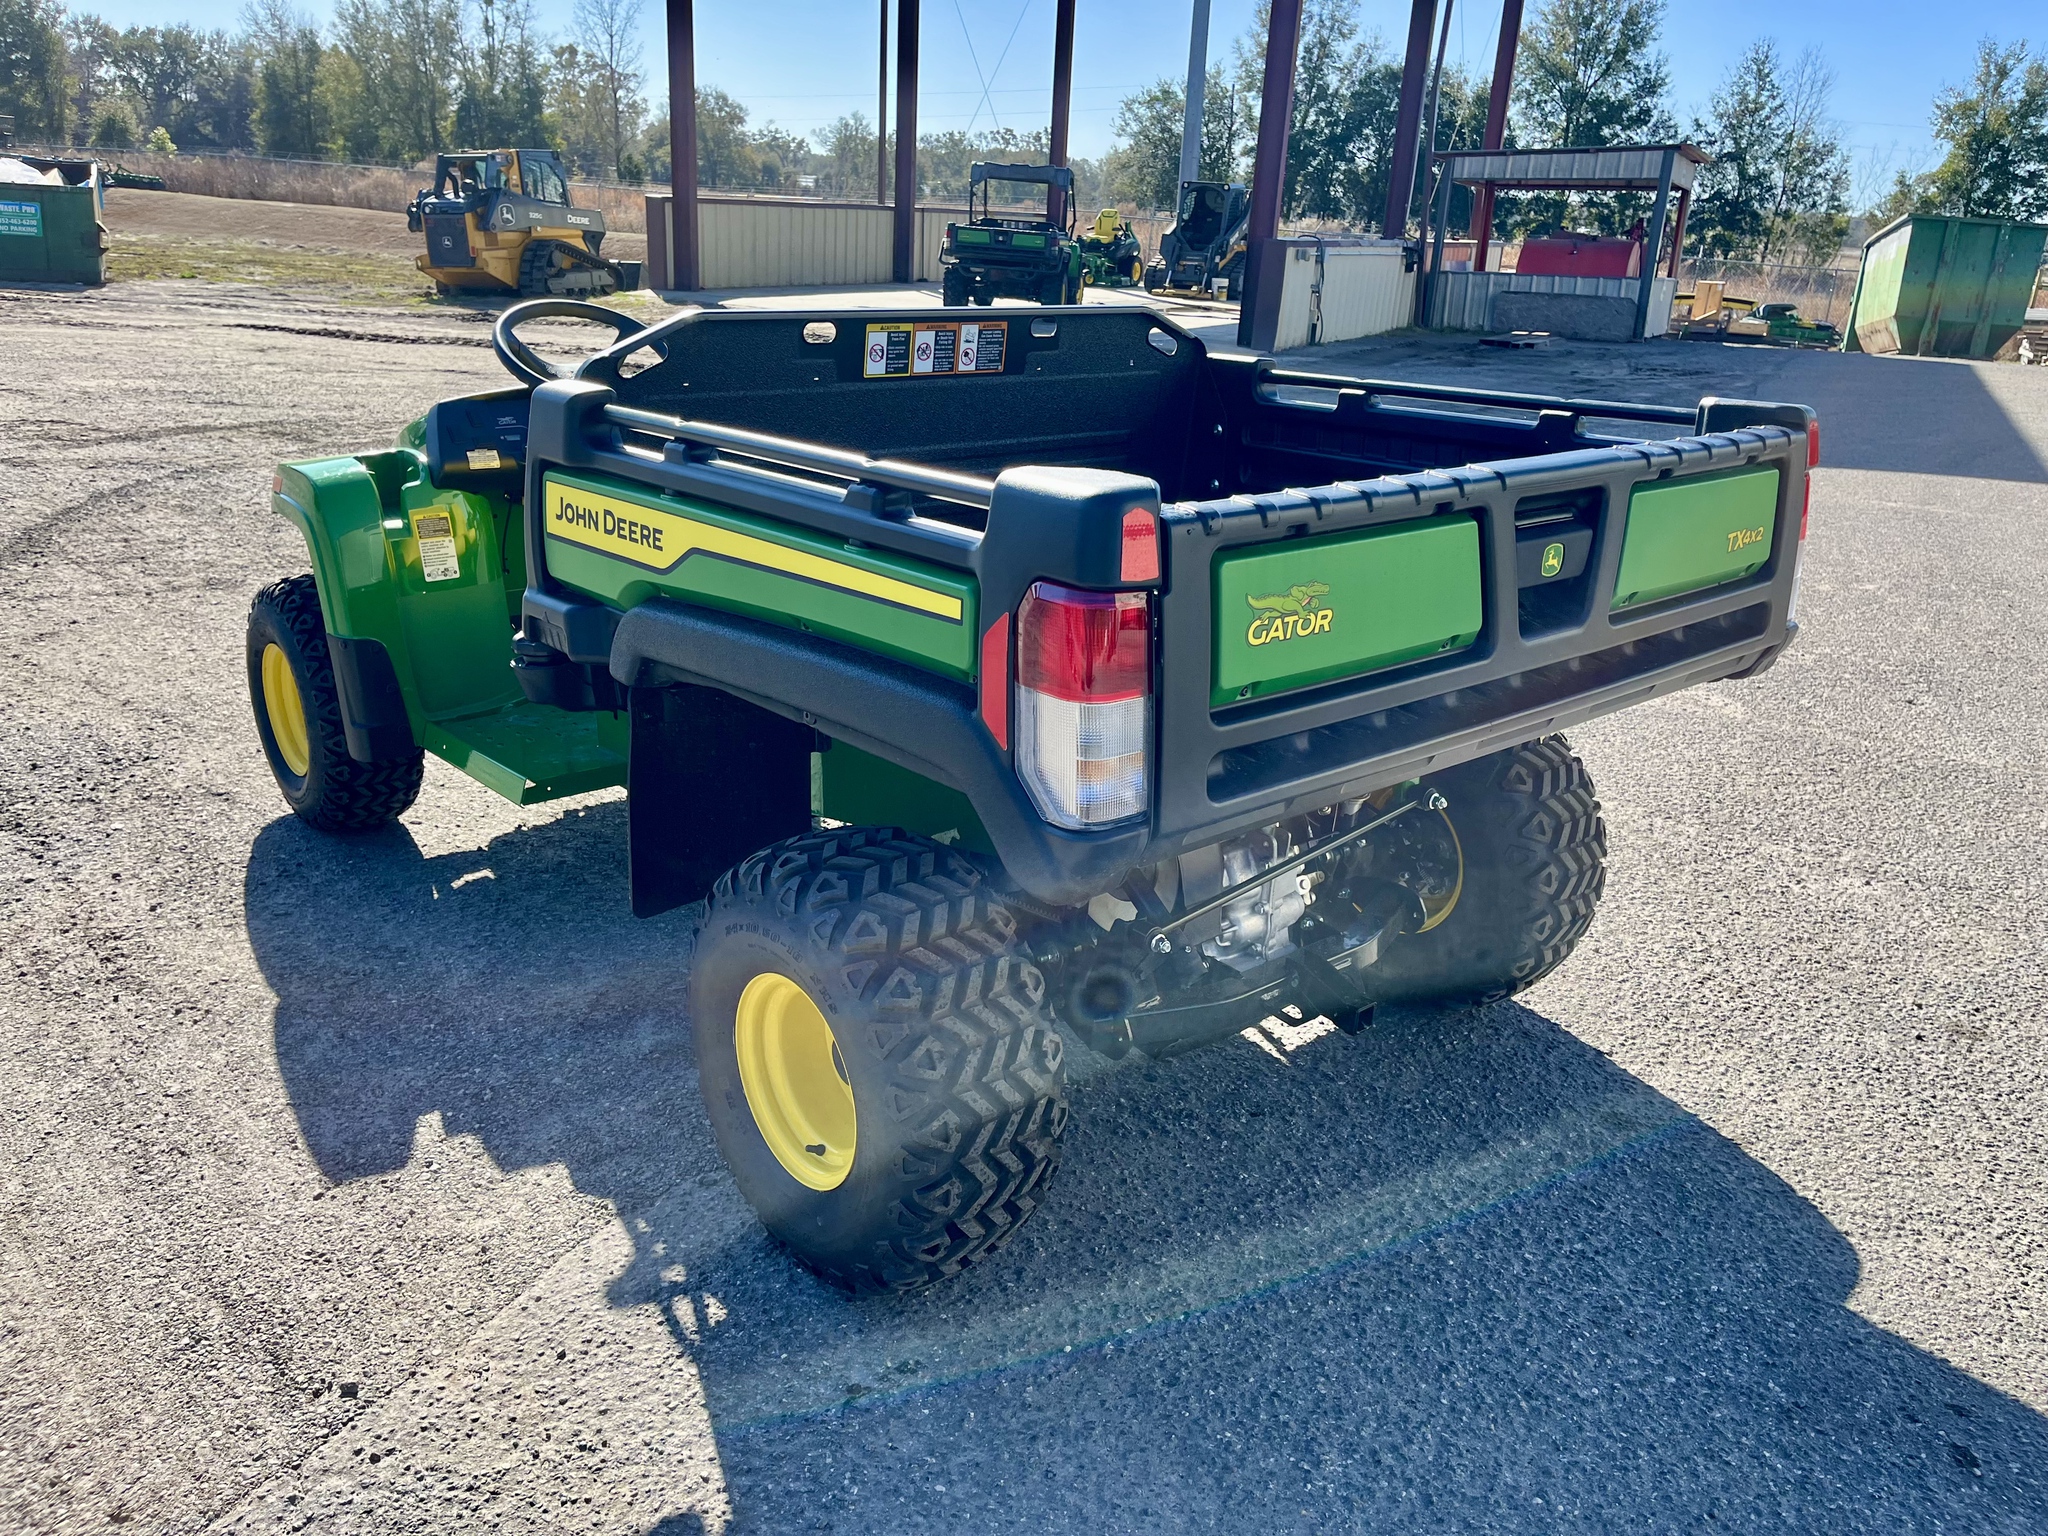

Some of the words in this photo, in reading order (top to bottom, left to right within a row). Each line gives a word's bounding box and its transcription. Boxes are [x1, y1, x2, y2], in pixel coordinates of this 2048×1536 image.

[10, 225, 37, 233] PARKING
[567, 214, 590, 225] DEERE
[555, 496, 599, 532] JOHN
[603, 508, 663, 552] DEERE
[1247, 608, 1333, 646] GATOR
